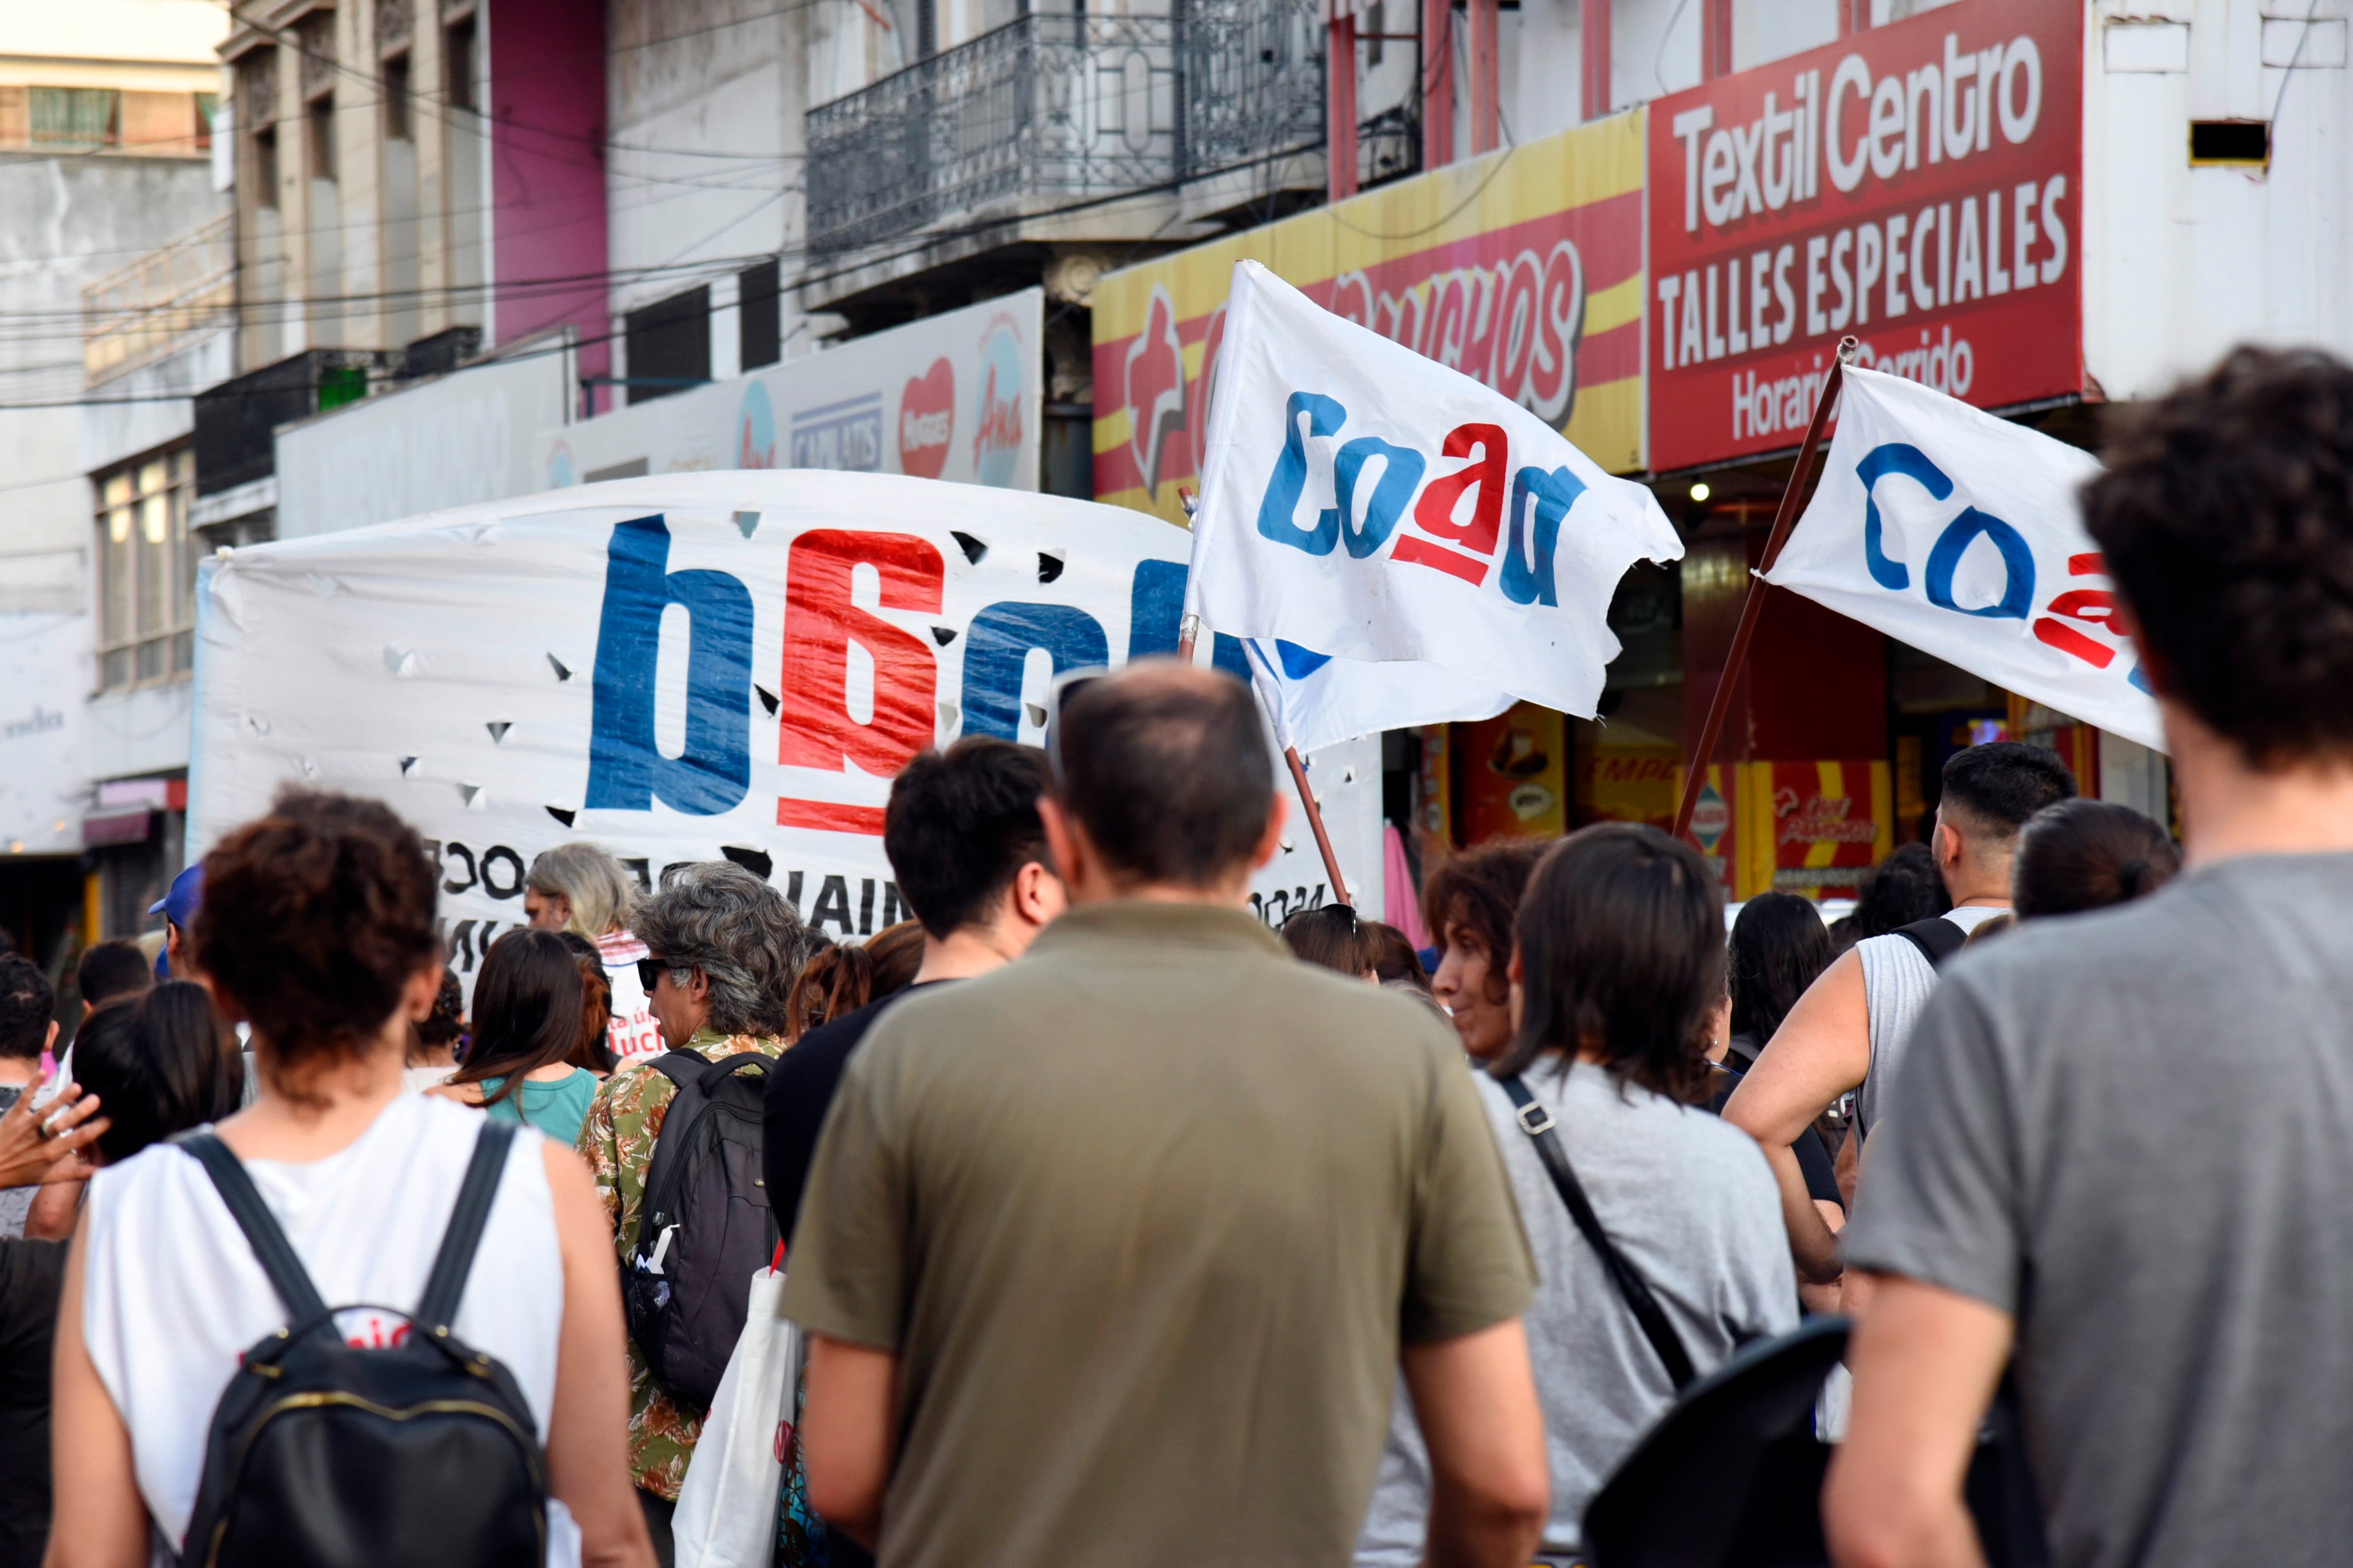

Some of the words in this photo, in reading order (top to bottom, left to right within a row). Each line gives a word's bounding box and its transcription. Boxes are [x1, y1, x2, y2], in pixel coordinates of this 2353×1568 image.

[1674, 69, 1820, 232] Textil
[1826, 33, 2042, 193] Centro
[1658, 244, 1796, 370] TALLES
[1806, 174, 2069, 337] ESPECIALES
[1853, 325, 1974, 398] rrido
[1856, 442, 2156, 696] Coa
